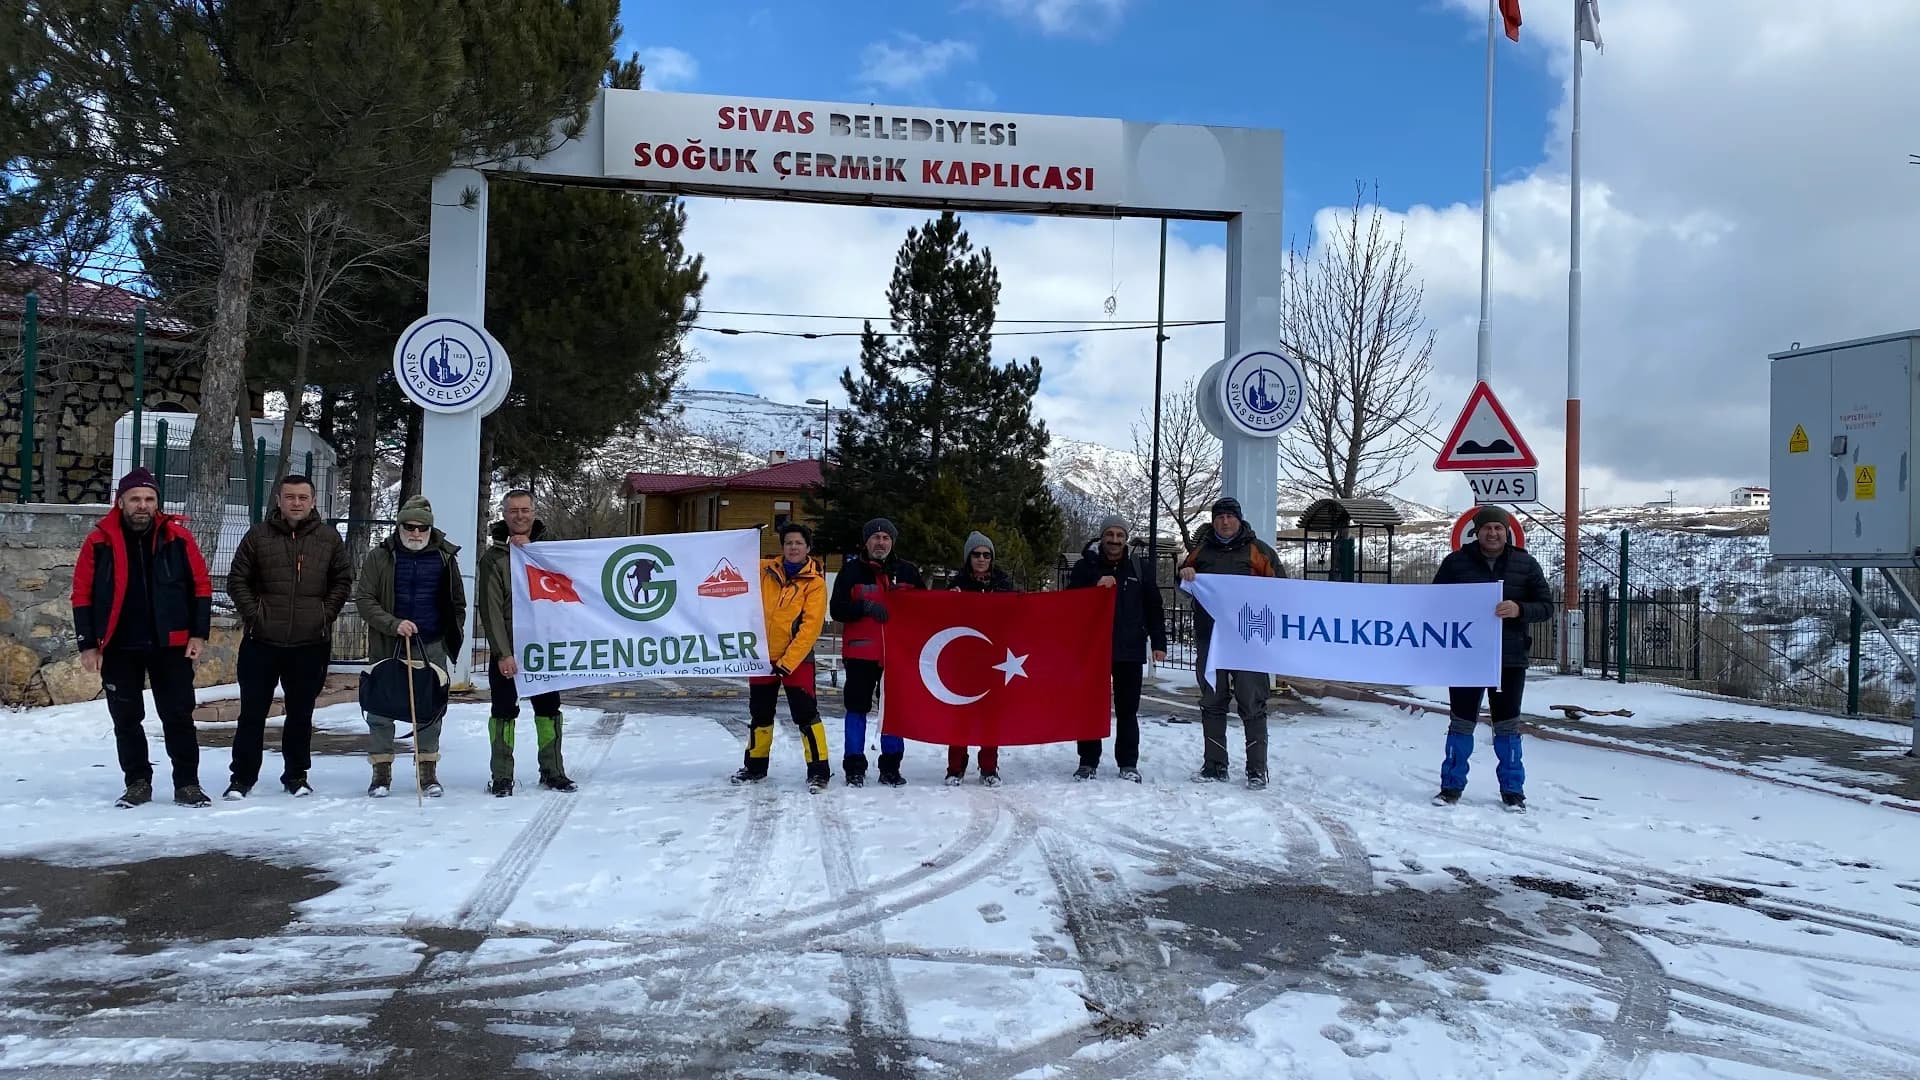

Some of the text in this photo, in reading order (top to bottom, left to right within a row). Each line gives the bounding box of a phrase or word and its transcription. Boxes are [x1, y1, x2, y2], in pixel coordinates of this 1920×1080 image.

[633, 138, 758, 174] SOĞUK
[922, 159, 1095, 192] KAPLICASI
[523, 631, 761, 673] GEZENGÖZLER
[1281, 614, 1473, 649] HALKBANK
